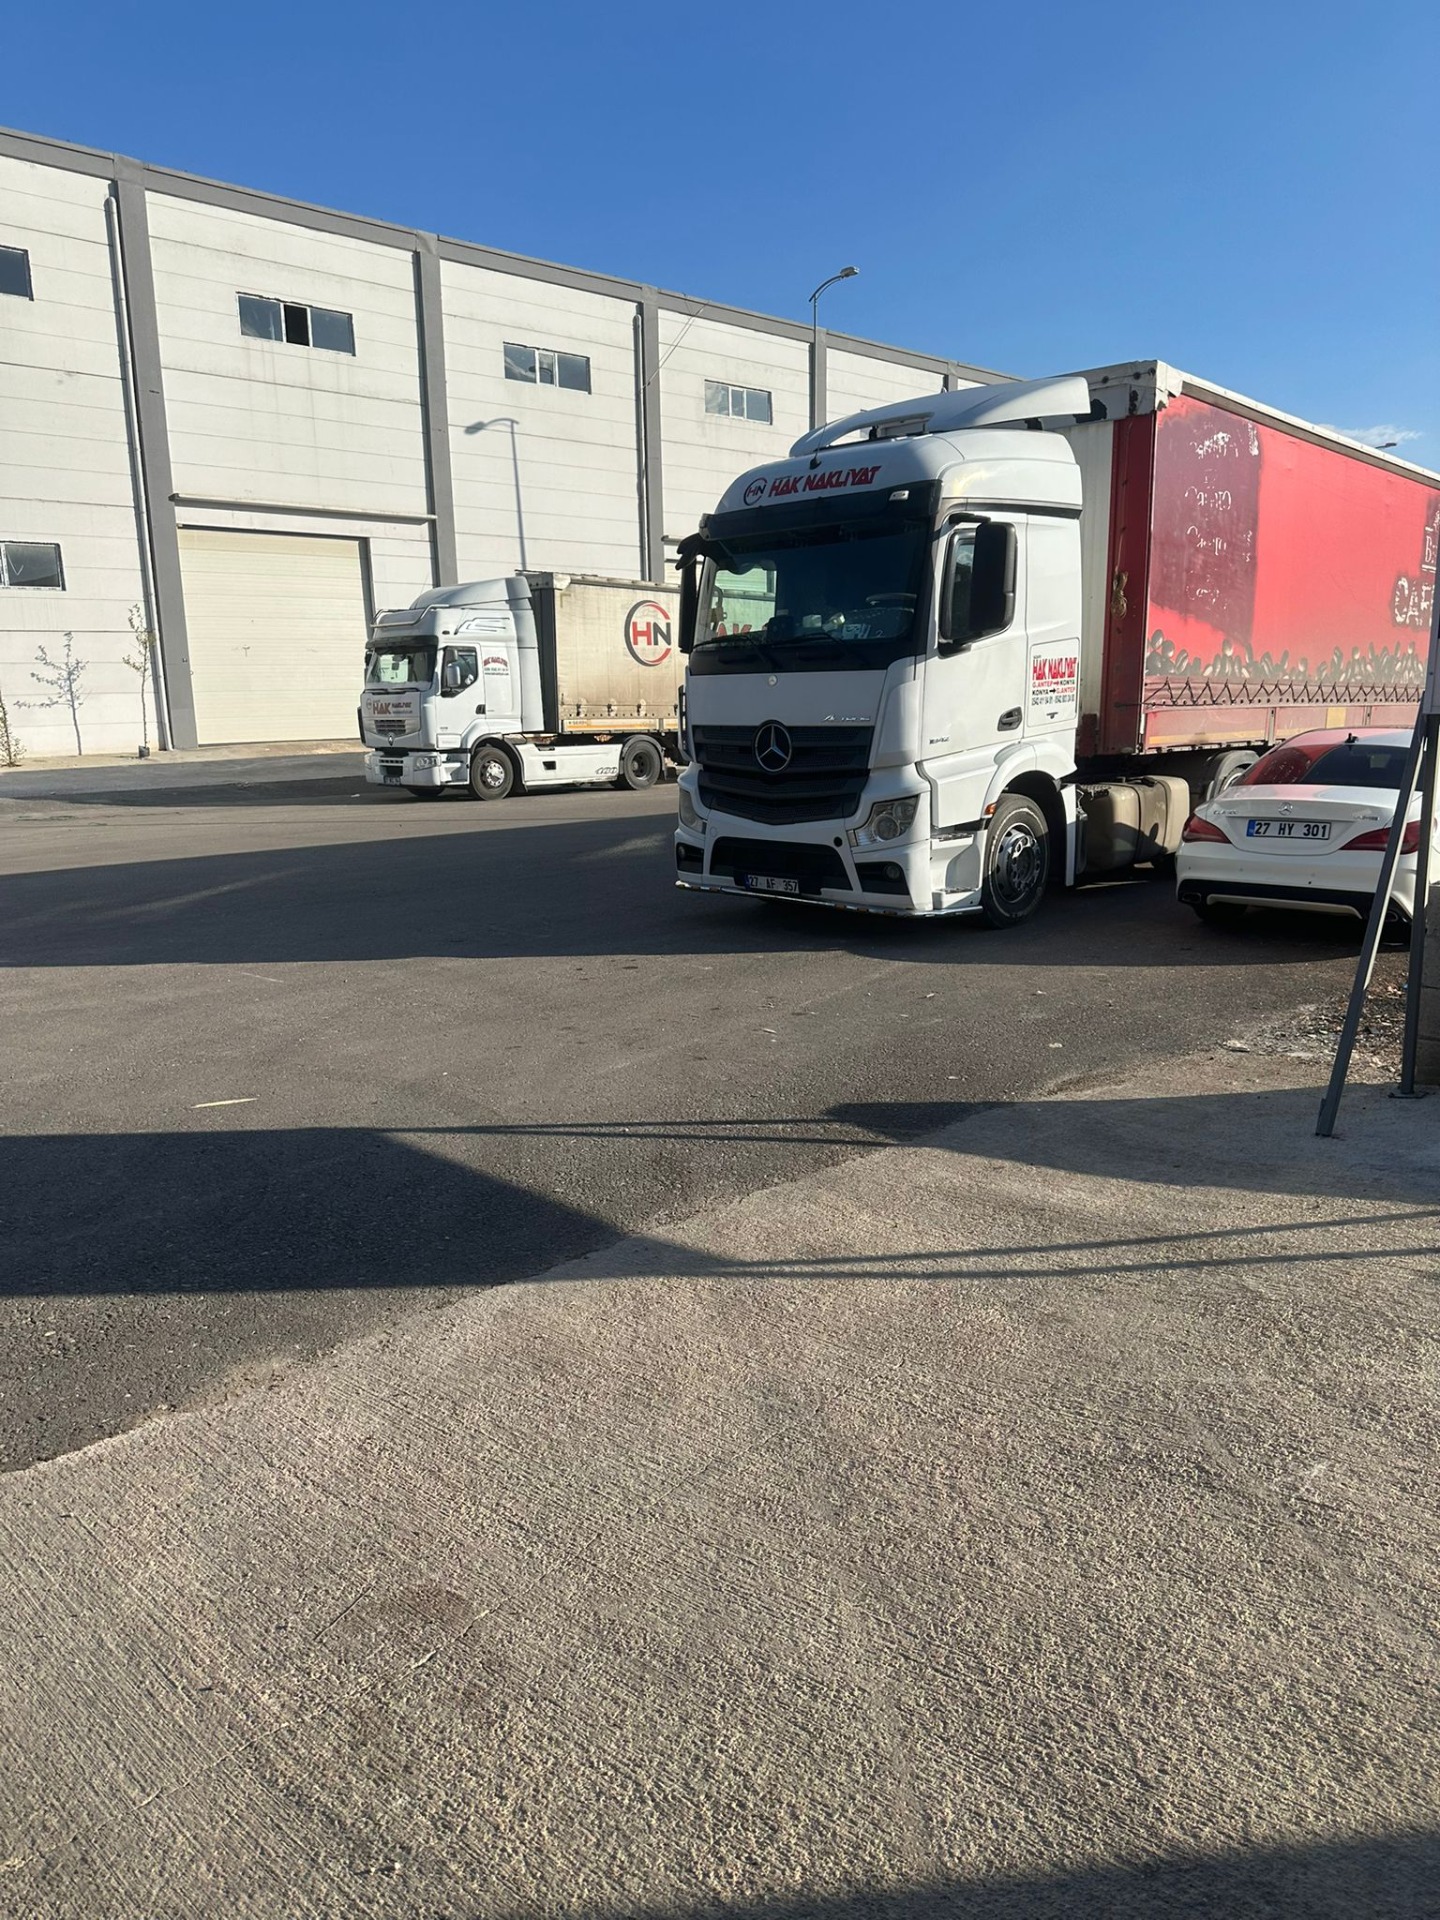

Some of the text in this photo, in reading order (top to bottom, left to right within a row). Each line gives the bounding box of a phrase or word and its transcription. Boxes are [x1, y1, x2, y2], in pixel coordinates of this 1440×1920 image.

[768, 476, 803, 498] HAK
[632, 621, 672, 646] HN
[1032, 659, 1047, 680] HAK
[372, 702, 391, 715] HAK
[1254, 822, 1327, 838] 27 HY 301
[749, 876, 759, 888] 27
[783, 879, 798, 892] 357
